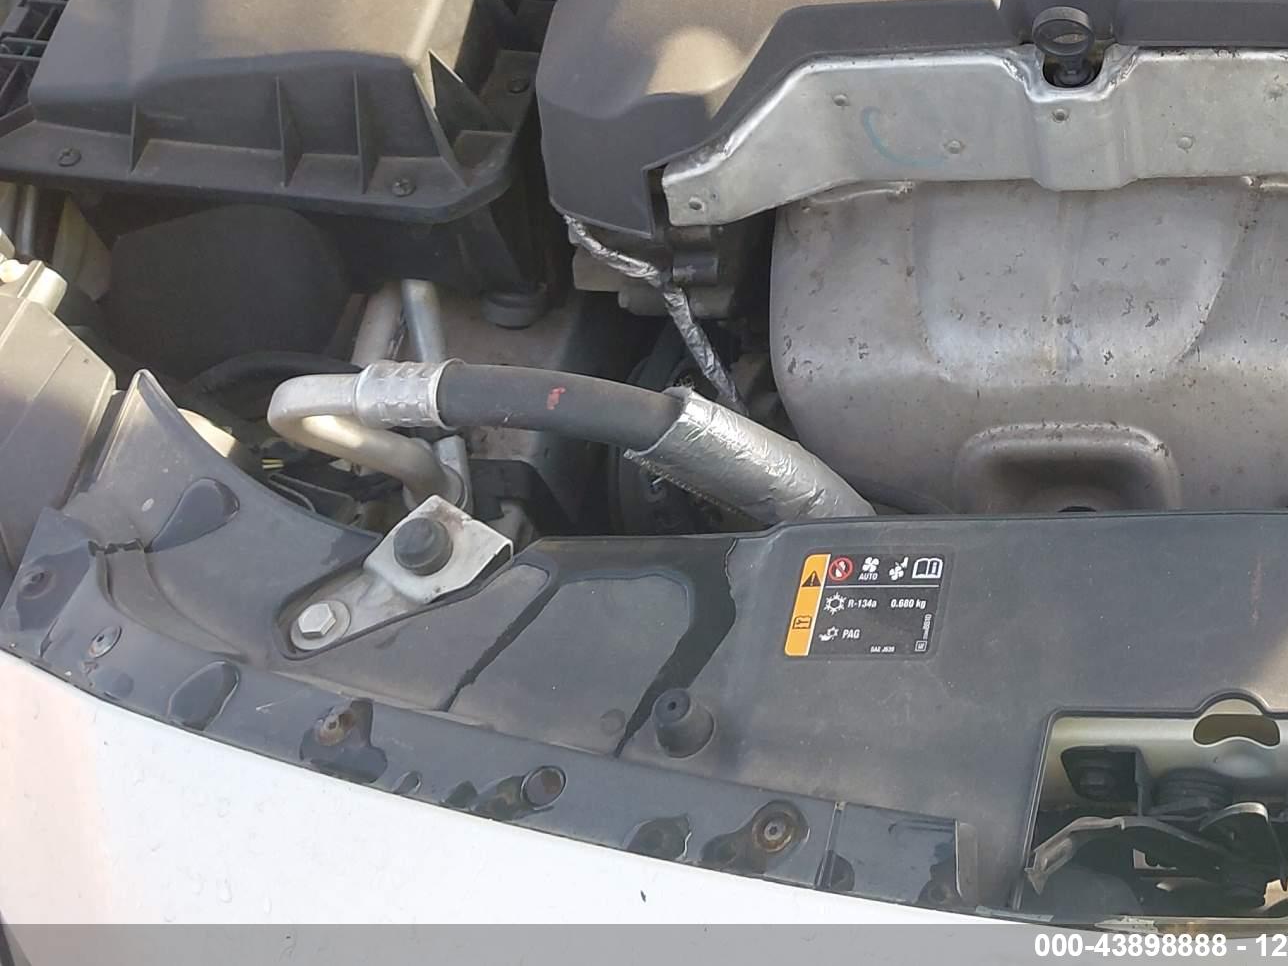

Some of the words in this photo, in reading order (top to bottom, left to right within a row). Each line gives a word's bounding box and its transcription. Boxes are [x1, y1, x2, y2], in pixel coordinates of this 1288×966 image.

[858, 573, 878, 581] AUTO
[847, 600, 877, 608] R-134a
[890, 599, 915, 608] 0.680
[916, 599, 927, 610] kg
[841, 629, 861, 639] PAG
